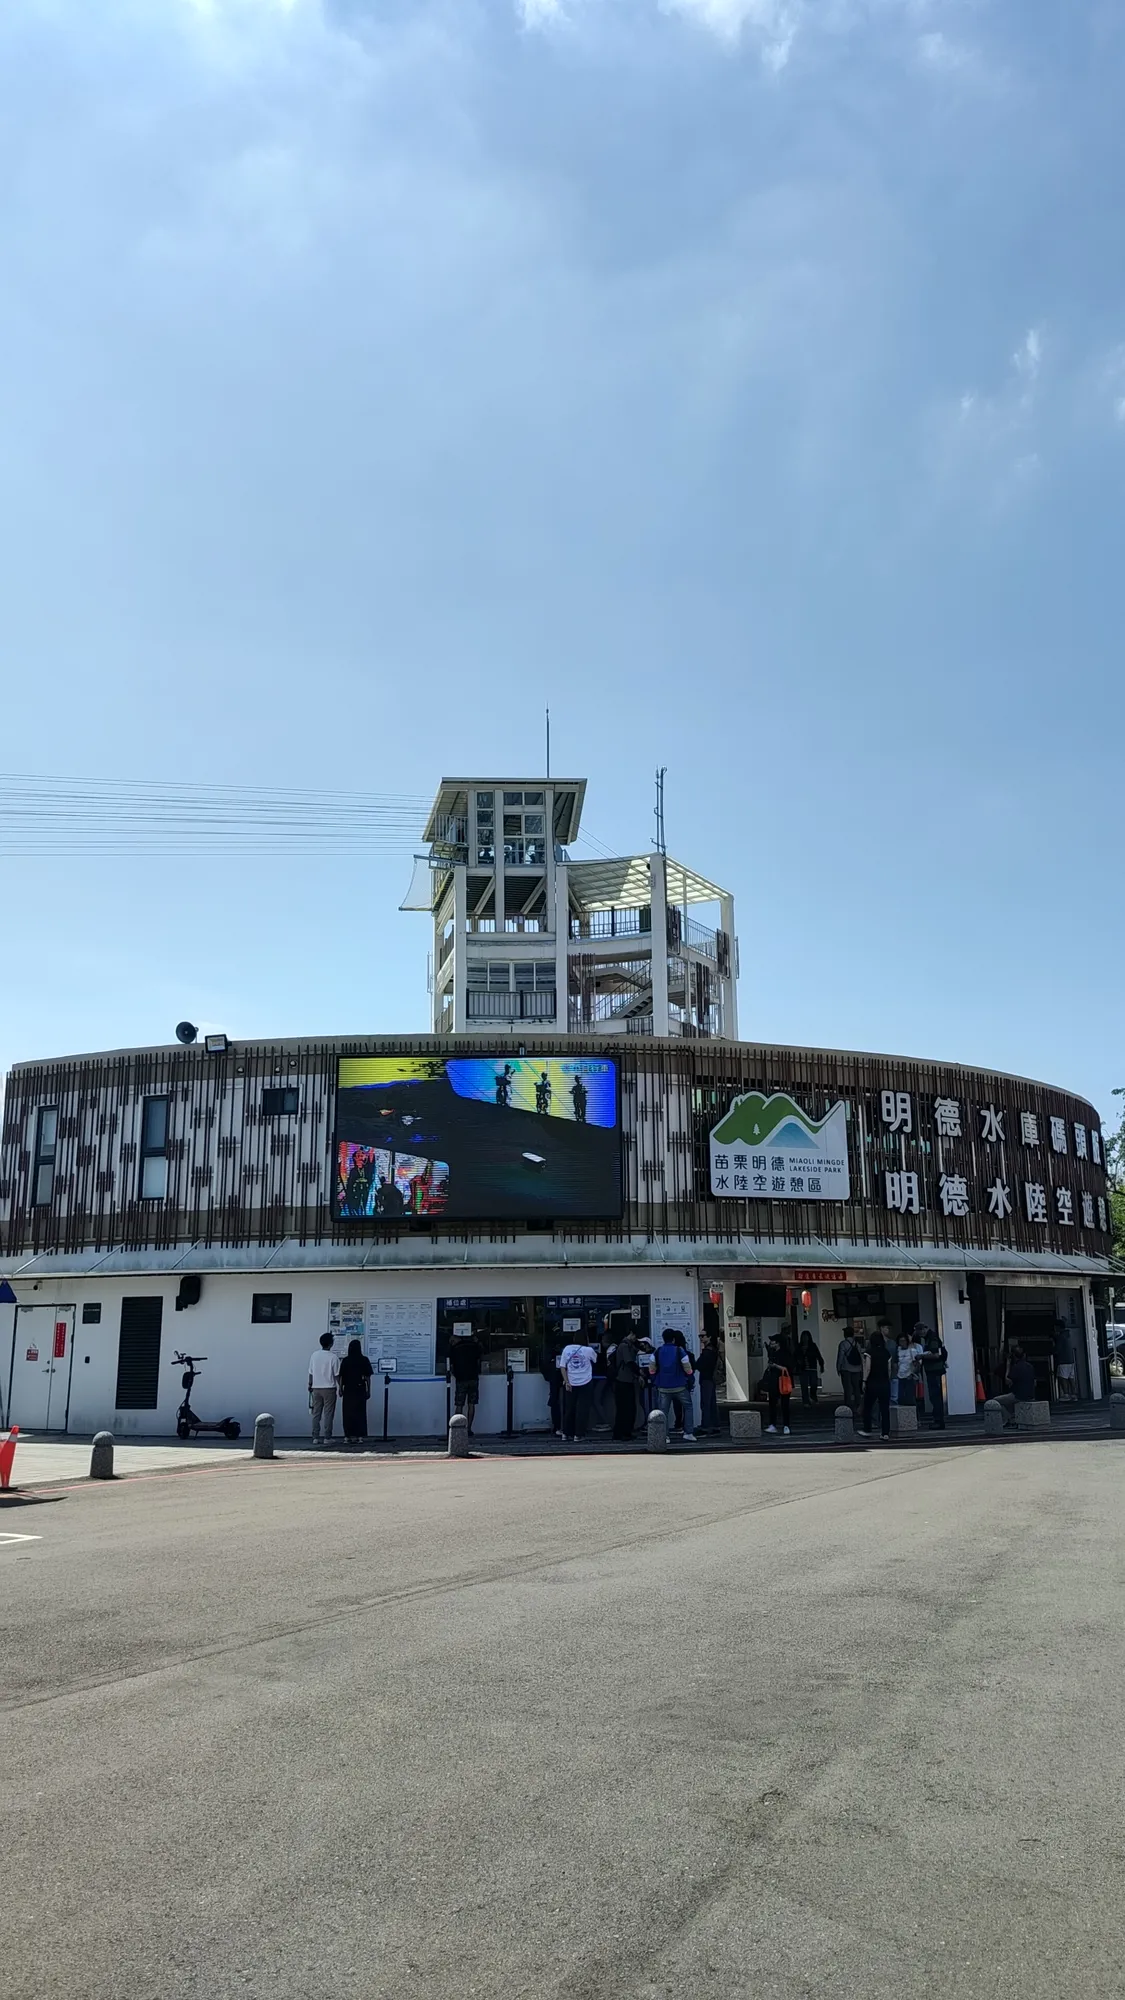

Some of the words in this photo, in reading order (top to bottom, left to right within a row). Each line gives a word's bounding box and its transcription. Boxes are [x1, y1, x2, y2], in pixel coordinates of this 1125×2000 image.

[880, 1089, 1107, 1170] 明德水庫碼頭服
[714, 1154, 785, 1172] 苗栗明德
[789, 1157, 815, 1165] MIAOLI
[817, 1158, 845, 1166] MINGDE
[789, 1165, 822, 1173] LAKESIDE
[824, 1166, 842, 1174] PARK
[715, 1174, 822, 1193] 水陸空遊憩區
[884, 1170, 1113, 1235] 明德水陸空遊憩
